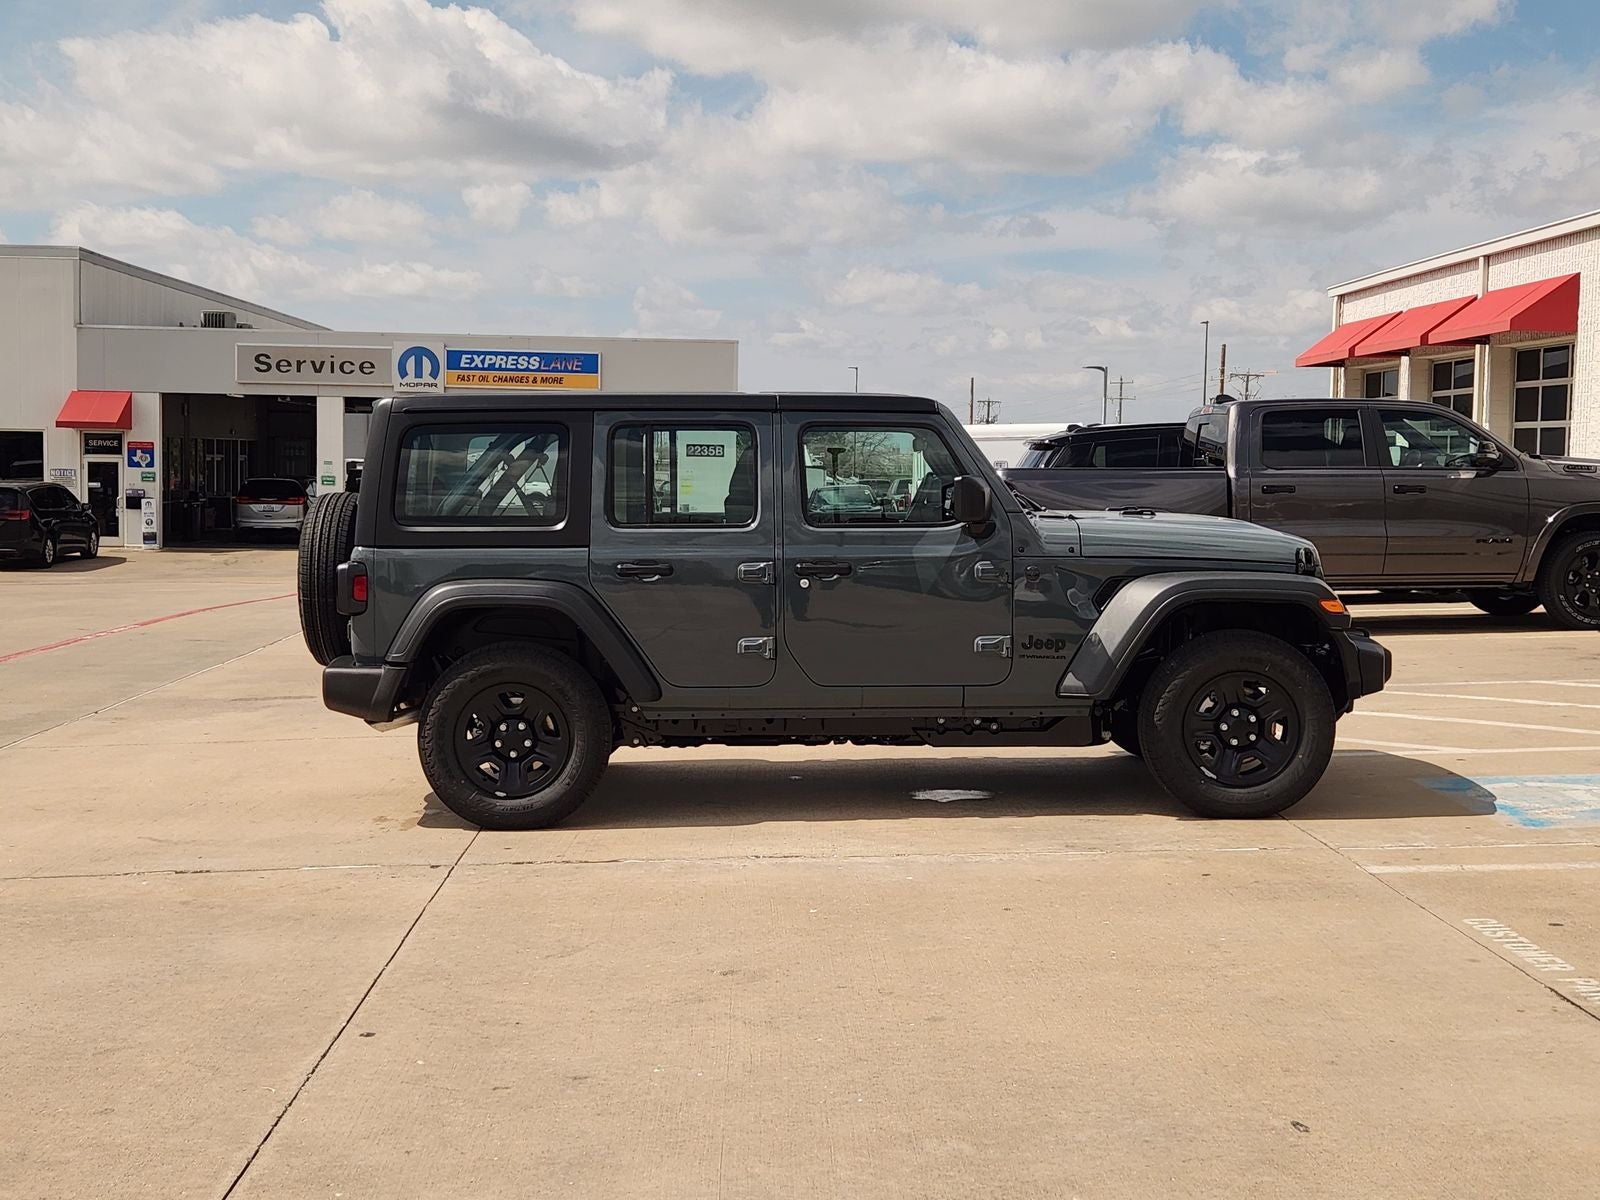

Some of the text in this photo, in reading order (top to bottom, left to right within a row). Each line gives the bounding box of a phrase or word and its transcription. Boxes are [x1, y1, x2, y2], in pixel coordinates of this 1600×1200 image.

[254, 353, 376, 375] Service
[456, 374, 565, 385] FAST OIL CHANGES & MORE
[88, 439, 119, 447] SERVICE
[687, 445, 724, 456] 2235B
[50, 469, 76, 477] NOTICE
[1021, 635, 1066, 652] Jeep
[1462, 918, 1576, 972] CUSTOMER
